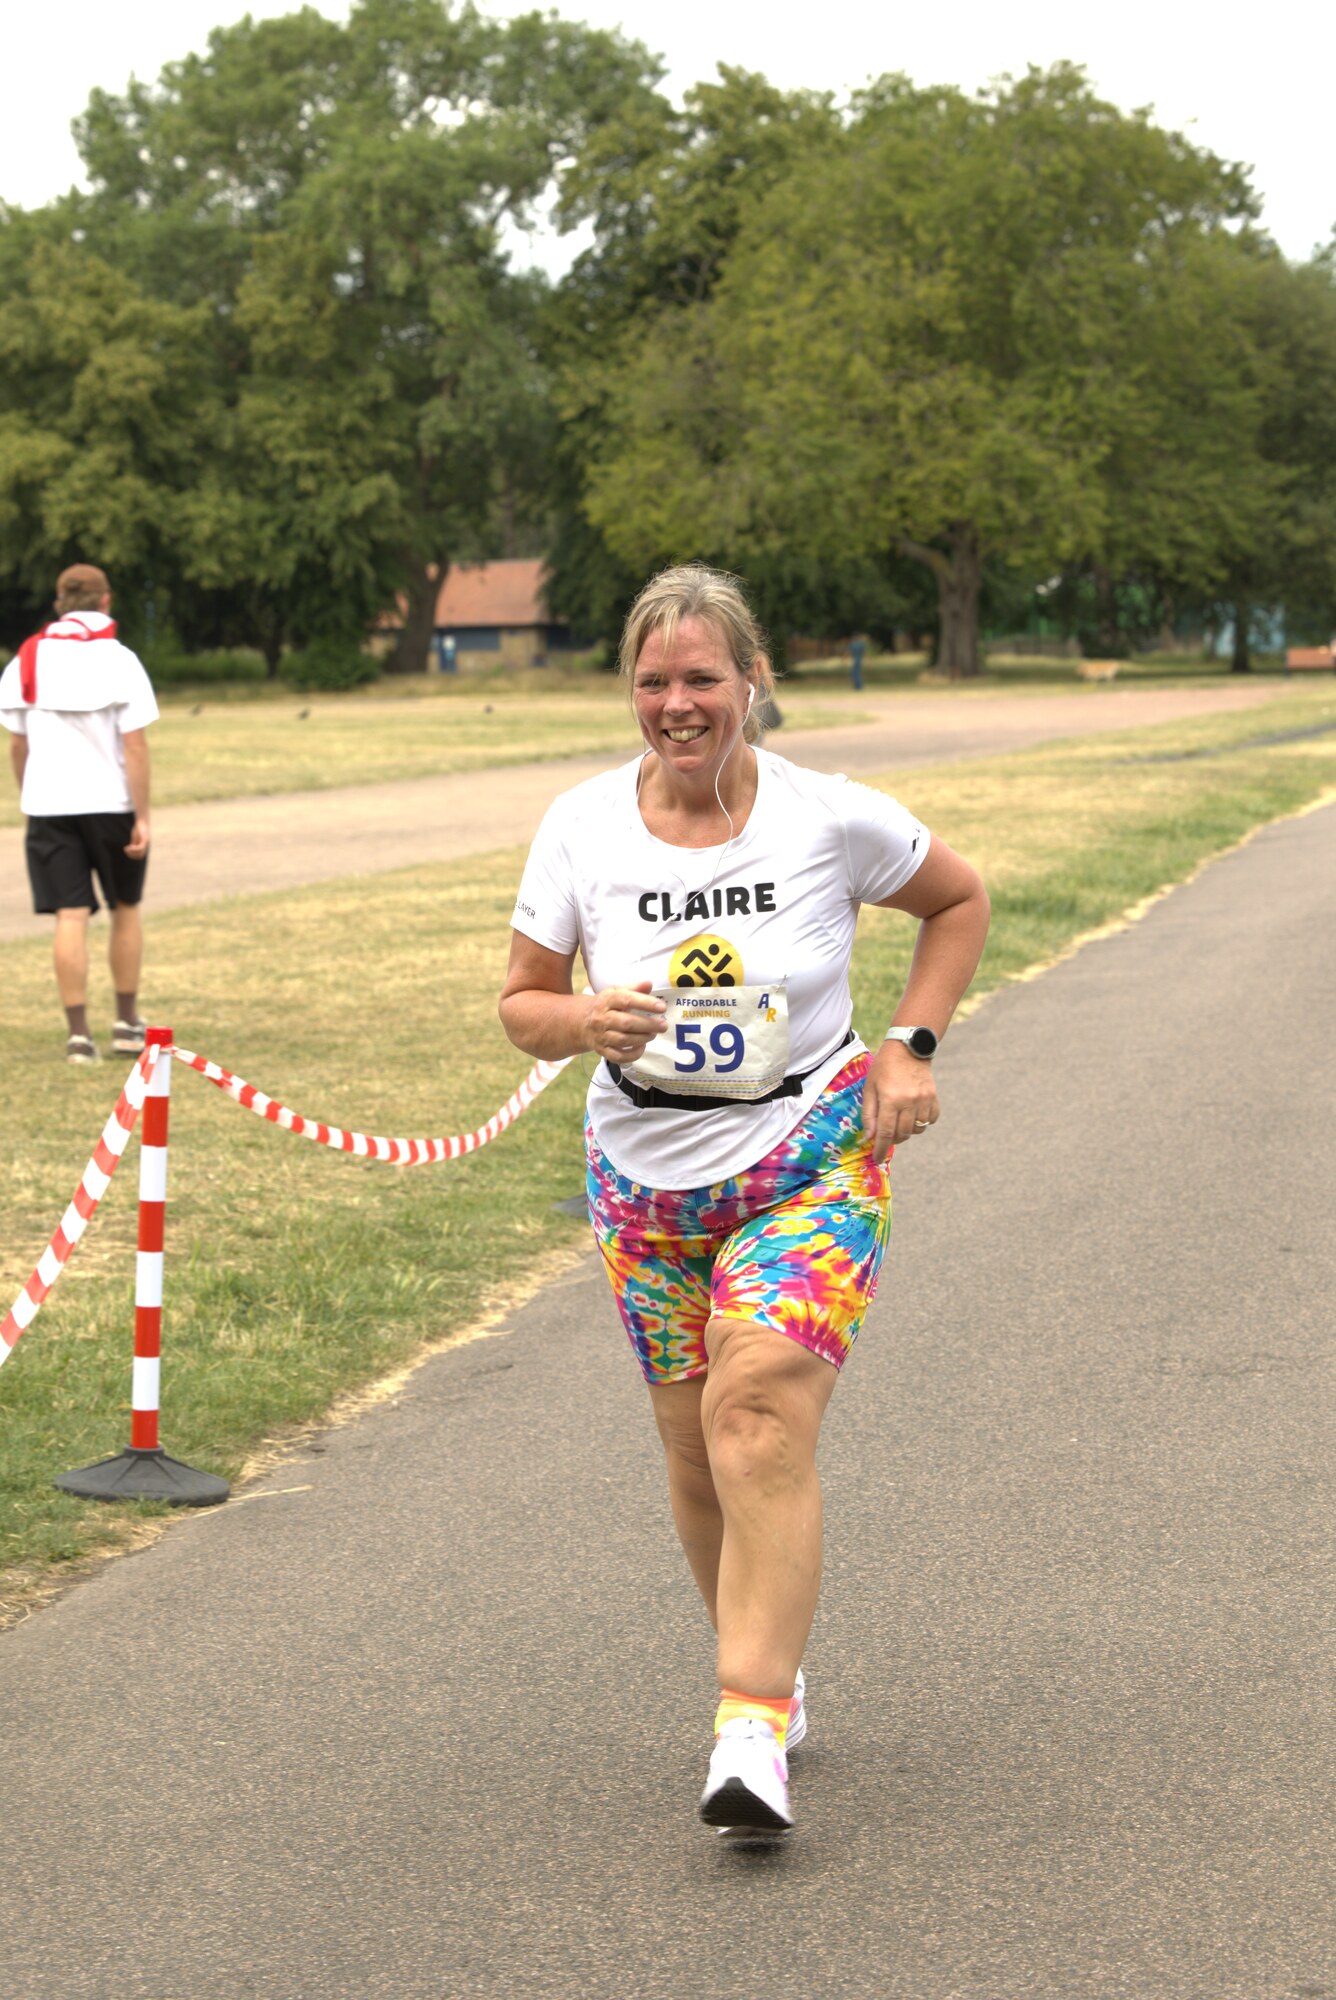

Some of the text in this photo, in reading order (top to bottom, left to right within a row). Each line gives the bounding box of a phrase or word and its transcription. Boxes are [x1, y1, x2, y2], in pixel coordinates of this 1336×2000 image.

[638, 882, 777, 922] CLAIRE
[675, 998, 737, 1007] AFFORDABLE
[682, 1010, 731, 1018] RUNNING
[674, 1023, 745, 1073] 59
